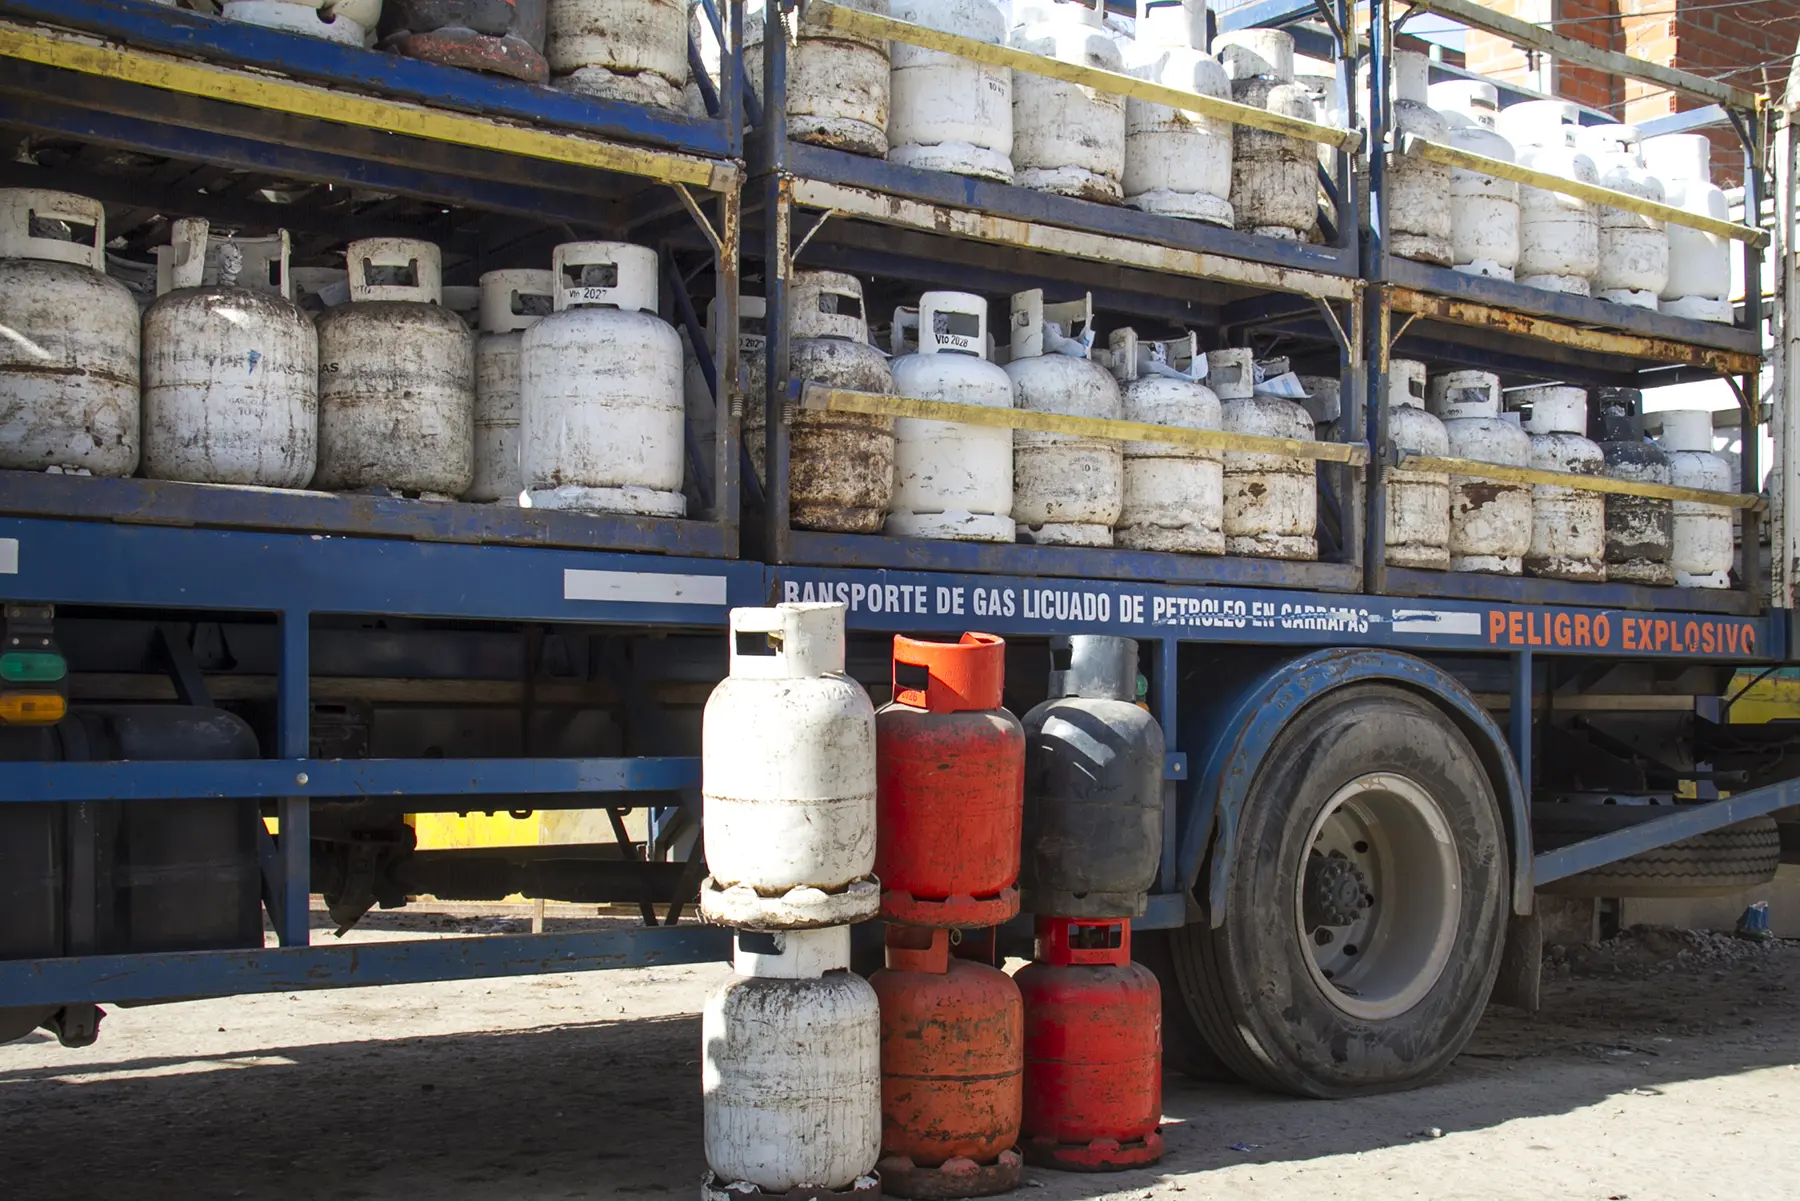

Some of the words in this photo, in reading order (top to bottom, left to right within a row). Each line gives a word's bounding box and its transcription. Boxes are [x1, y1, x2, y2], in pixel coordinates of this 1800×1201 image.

[934, 333, 950, 344] Vto
[950, 333, 969, 348] 2028
[319, 362, 340, 373] AS
[936, 586, 965, 616] DE
[973, 587, 1016, 618] GAS
[1023, 588, 1111, 623] LICUADO
[1119, 594, 1145, 624] DE
[1152, 596, 1246, 629] PETROLEO
[1252, 601, 1276, 628] EN
[1280, 602, 1369, 634] GARRAFAS
[1489, 610, 1611, 648] PELIGRO
[1622, 617, 1756, 655] EXPLOSIVO
